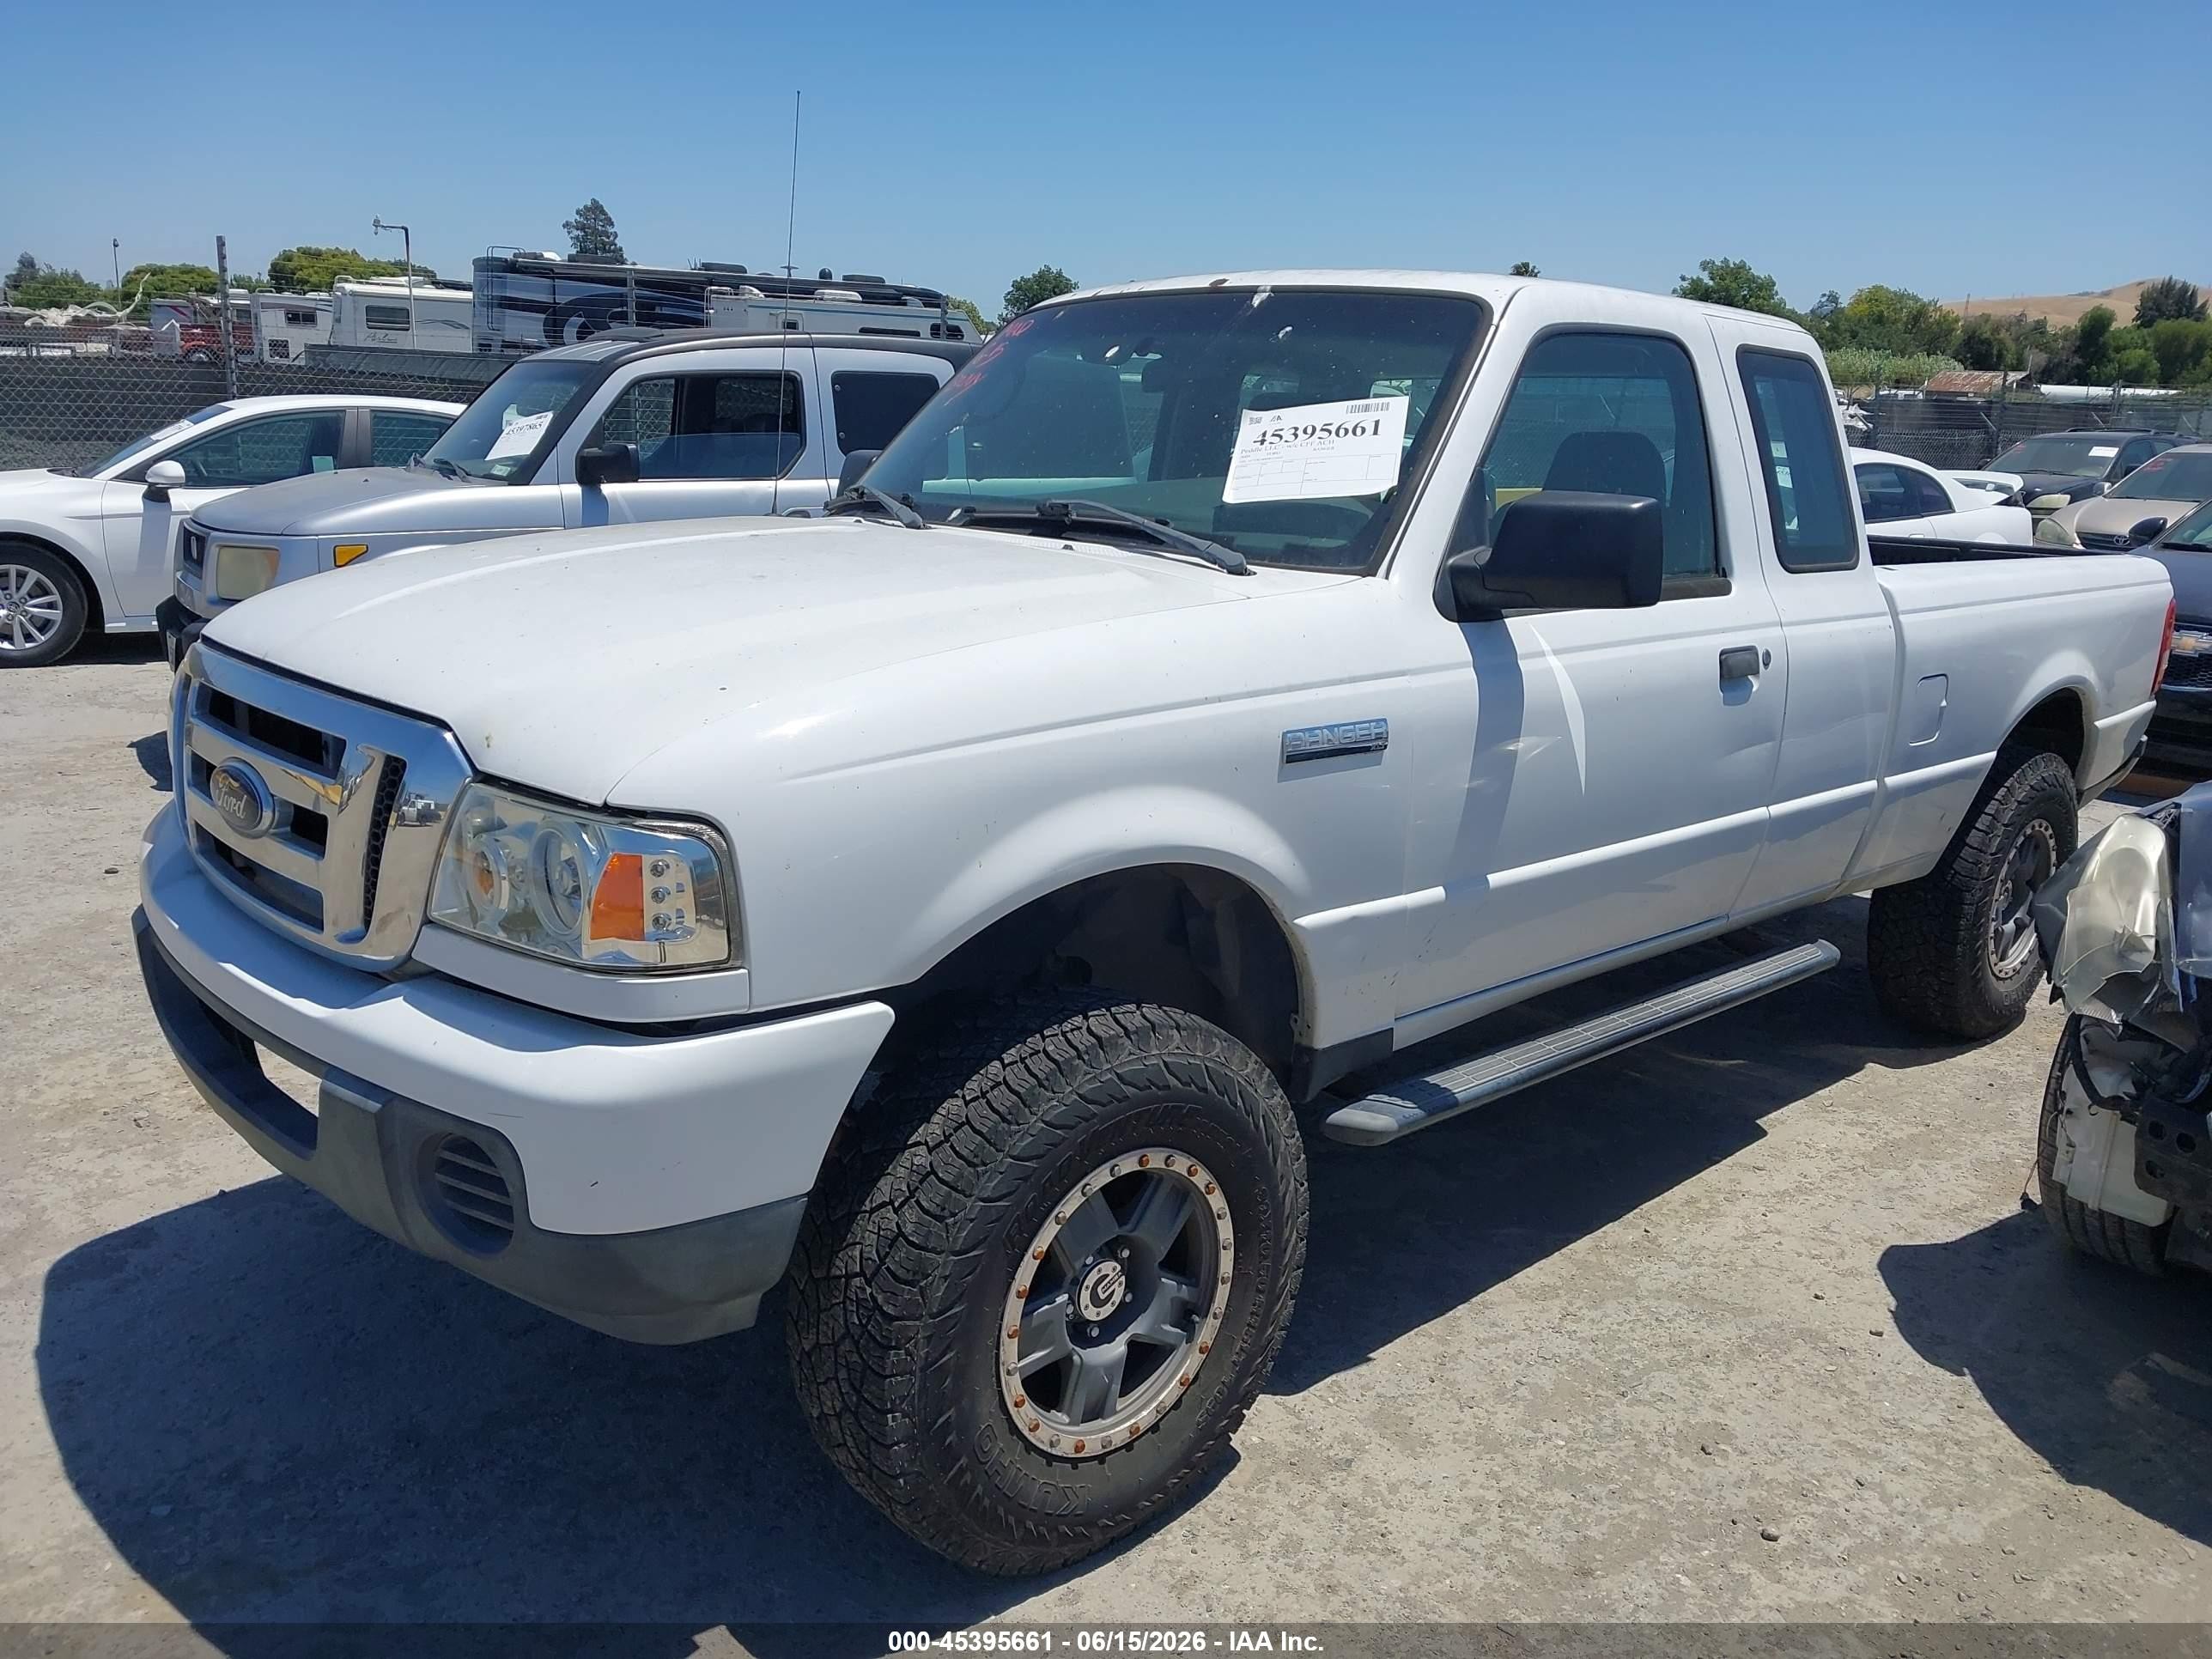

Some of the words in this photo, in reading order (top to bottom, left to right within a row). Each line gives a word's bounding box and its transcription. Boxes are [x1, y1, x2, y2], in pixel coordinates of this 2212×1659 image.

[1253, 418, 1382, 447] 45395661
[1286, 721, 1388, 751] RANGER
[216, 772, 247, 819] Ford
[974, 1422, 1090, 1516] KUMHO
